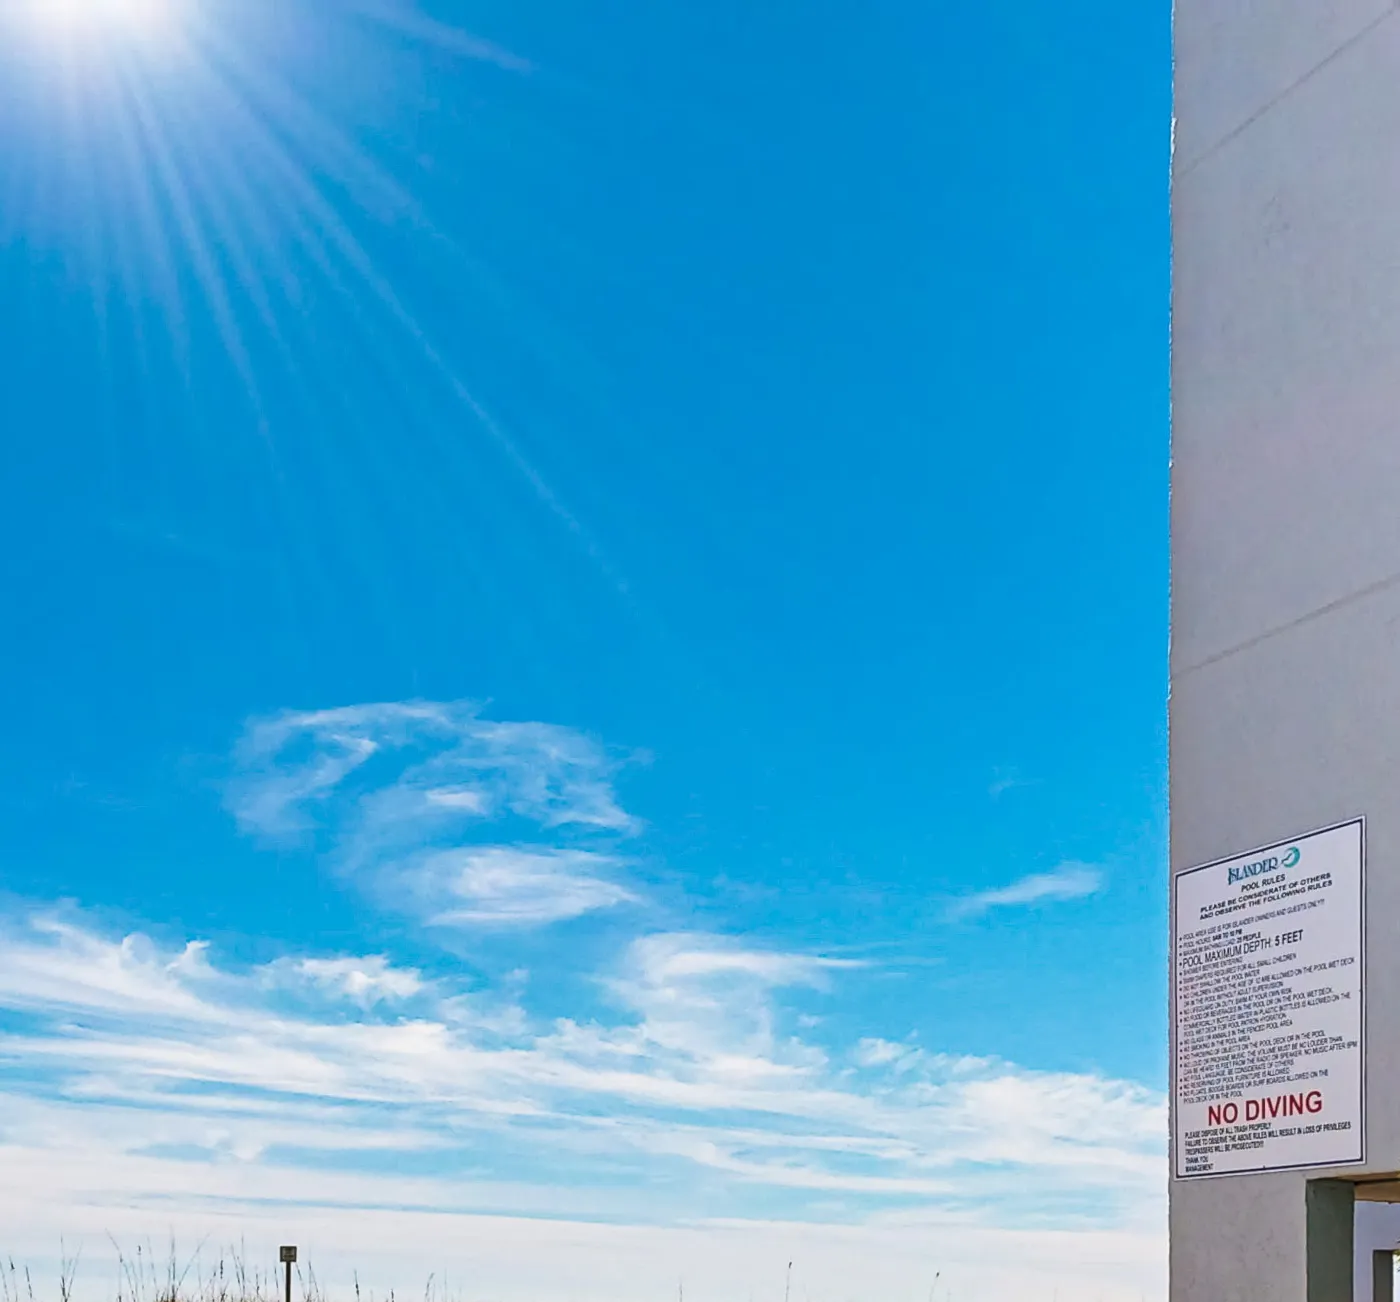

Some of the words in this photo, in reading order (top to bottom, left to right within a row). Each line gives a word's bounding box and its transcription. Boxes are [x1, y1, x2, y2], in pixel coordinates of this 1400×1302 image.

[1227, 857, 1279, 885] ISLANDER
[1200, 901, 1225, 913] PLEASE
[1238, 884, 1286, 903] CONSIDERATE
[1288, 881, 1297, 889] OF
[1299, 873, 1330, 886] OTHERS
[1241, 881, 1259, 892] POOL
[1261, 874, 1285, 886] RULES
[1200, 911, 1212, 920] AND
[1215, 902, 1245, 916] OBSERVE
[1248, 899, 1260, 907] THE
[1263, 887, 1305, 903] FOLLOWING
[1307, 880, 1332, 892] RULES
[1182, 953, 1202, 968] POOL
[1204, 944, 1241, 963] MAXIMUM
[1274, 935, 1279, 947] 5
[1282, 929, 1303, 945] FEET
[1318, 1069, 1328, 1077] THE
[1230, 1090, 1242, 1098] POOL
[1208, 1102, 1237, 1126] NO
[1245, 1090, 1322, 1121] DIVING
[1185, 1130, 1200, 1139] PLEASE
[1201, 1128, 1218, 1137] DISPOSE
[1233, 1125, 1247, 1133] TRASH
[1248, 1122, 1271, 1132] PROPERLY
[1185, 1138, 1200, 1147] FAILURE
[1208, 1135, 1227, 1144] OBSERVE
[1228, 1134, 1236, 1142] THE
[1237, 1132, 1252, 1141] ABOVE
[1253, 1131, 1267, 1139] RULES
[1268, 1129, 1278, 1138] WILL
[1279, 1127, 1296, 1137] RESULT
[1303, 1125, 1315, 1134] LOSS
[1323, 1121, 1351, 1132] PRIVILEGES
[1214, 1144, 1223, 1152] WILL
[1185, 1156, 1199, 1164] THANK
